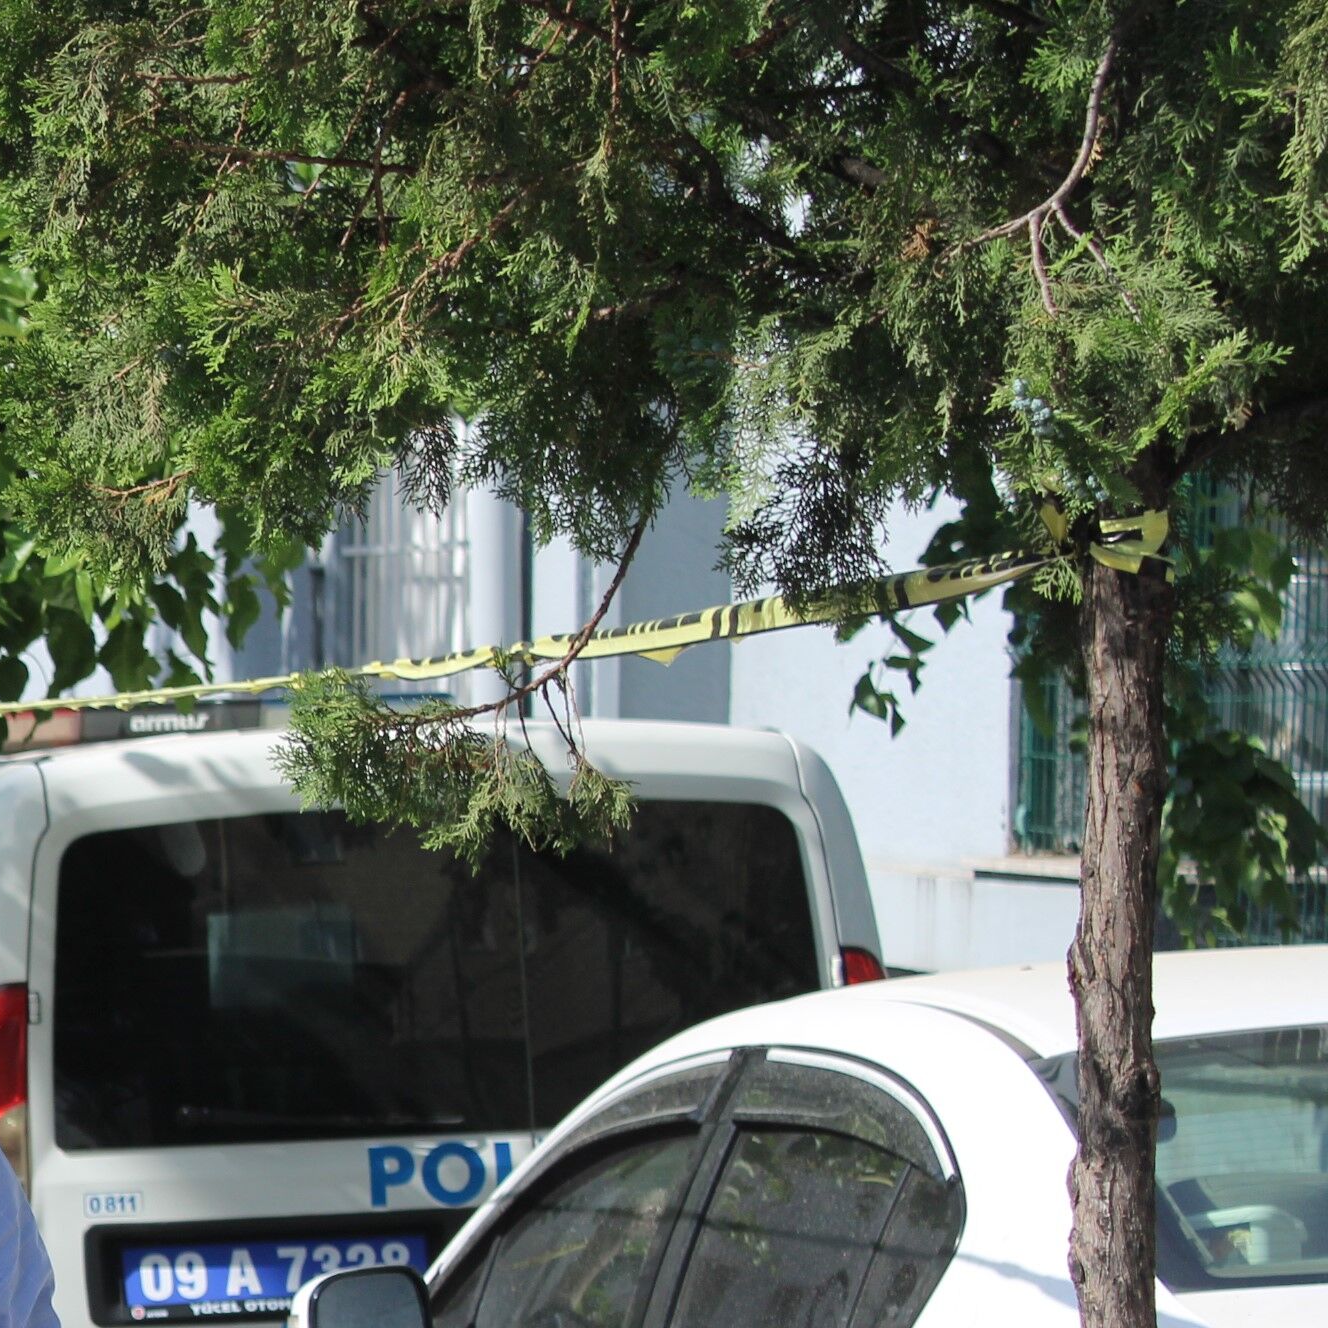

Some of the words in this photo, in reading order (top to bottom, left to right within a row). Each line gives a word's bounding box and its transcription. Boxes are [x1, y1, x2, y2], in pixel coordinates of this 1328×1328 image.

[139, 1251, 209, 1301] 09
[226, 1248, 263, 1296] A
[191, 1299, 242, 1316] YÜCEL
